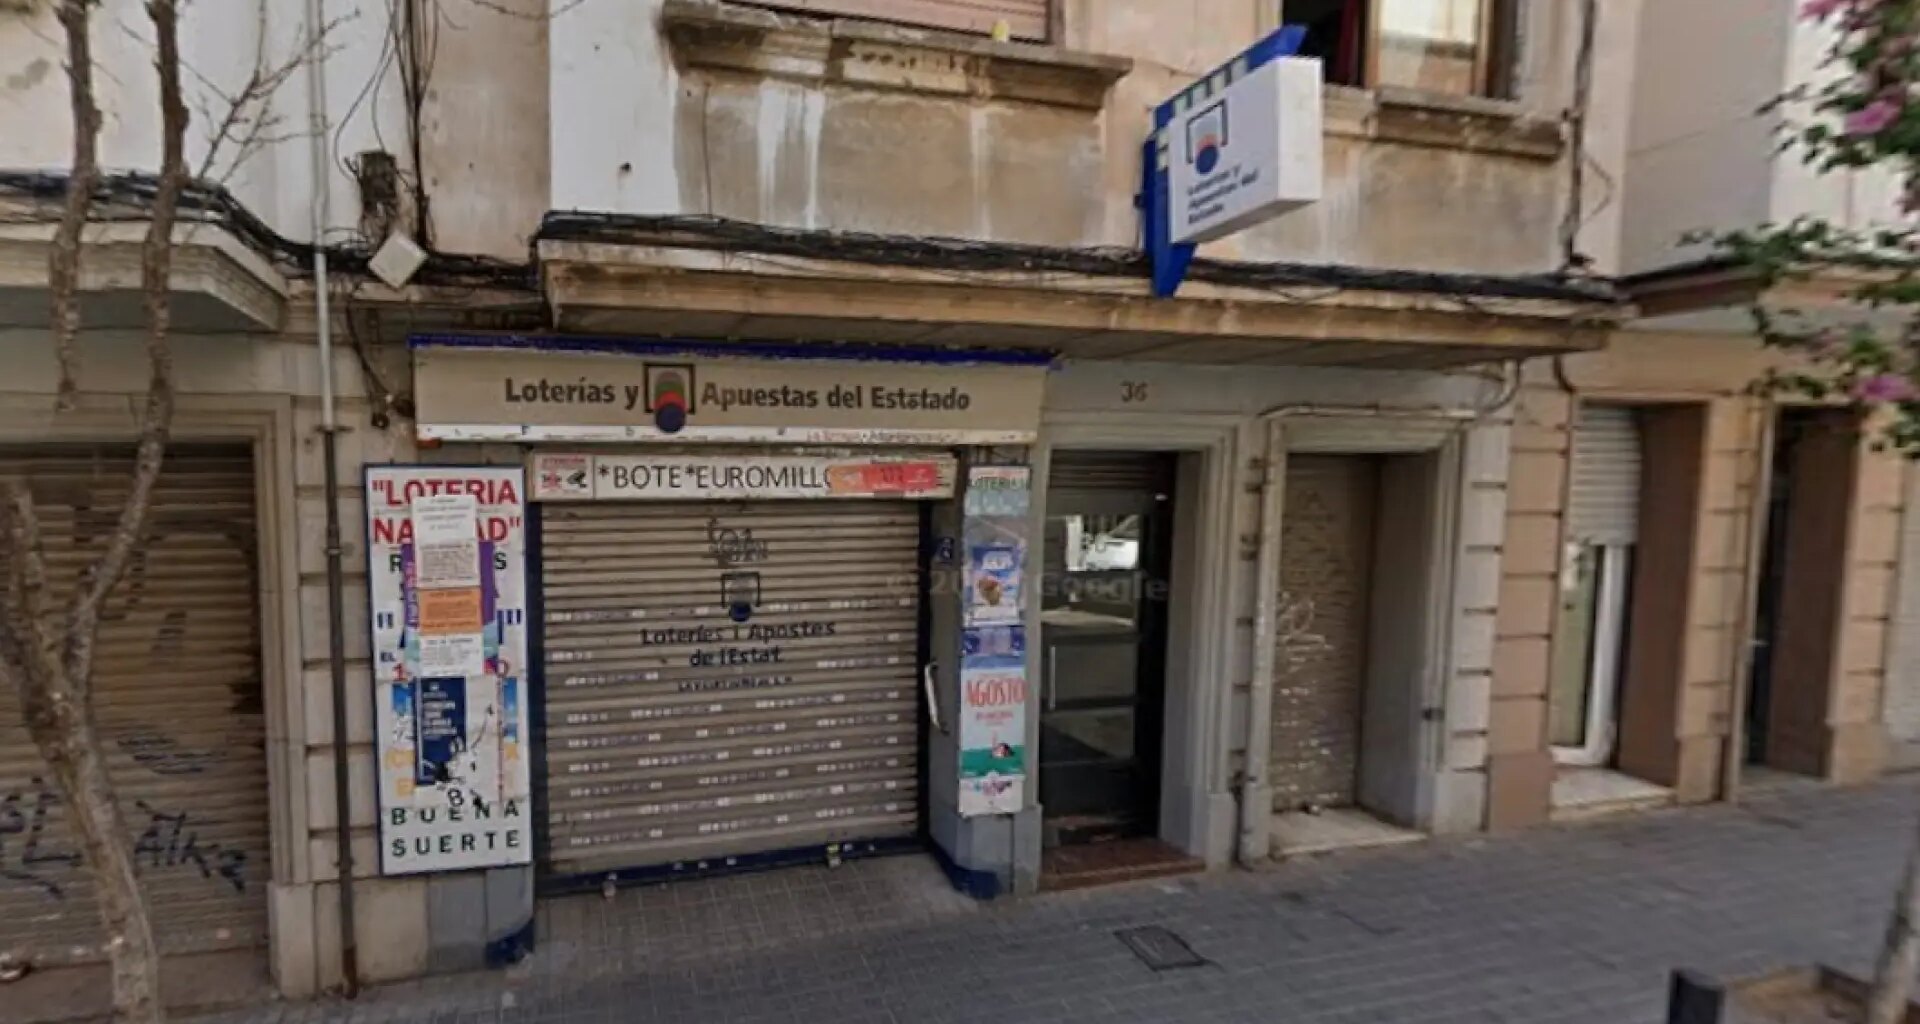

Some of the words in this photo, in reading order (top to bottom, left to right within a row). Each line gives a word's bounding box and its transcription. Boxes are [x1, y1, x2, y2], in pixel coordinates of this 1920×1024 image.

[505, 376, 616, 403] Loterías
[624, 385, 639, 410] y
[701, 382, 819, 411] Apuestas
[826, 384, 862, 409] del
[748, 621, 837, 644] Apostes
[690, 649, 714, 667] de
[391, 799, 520, 826] BUENA
[391, 820, 521, 857] SUERTE
